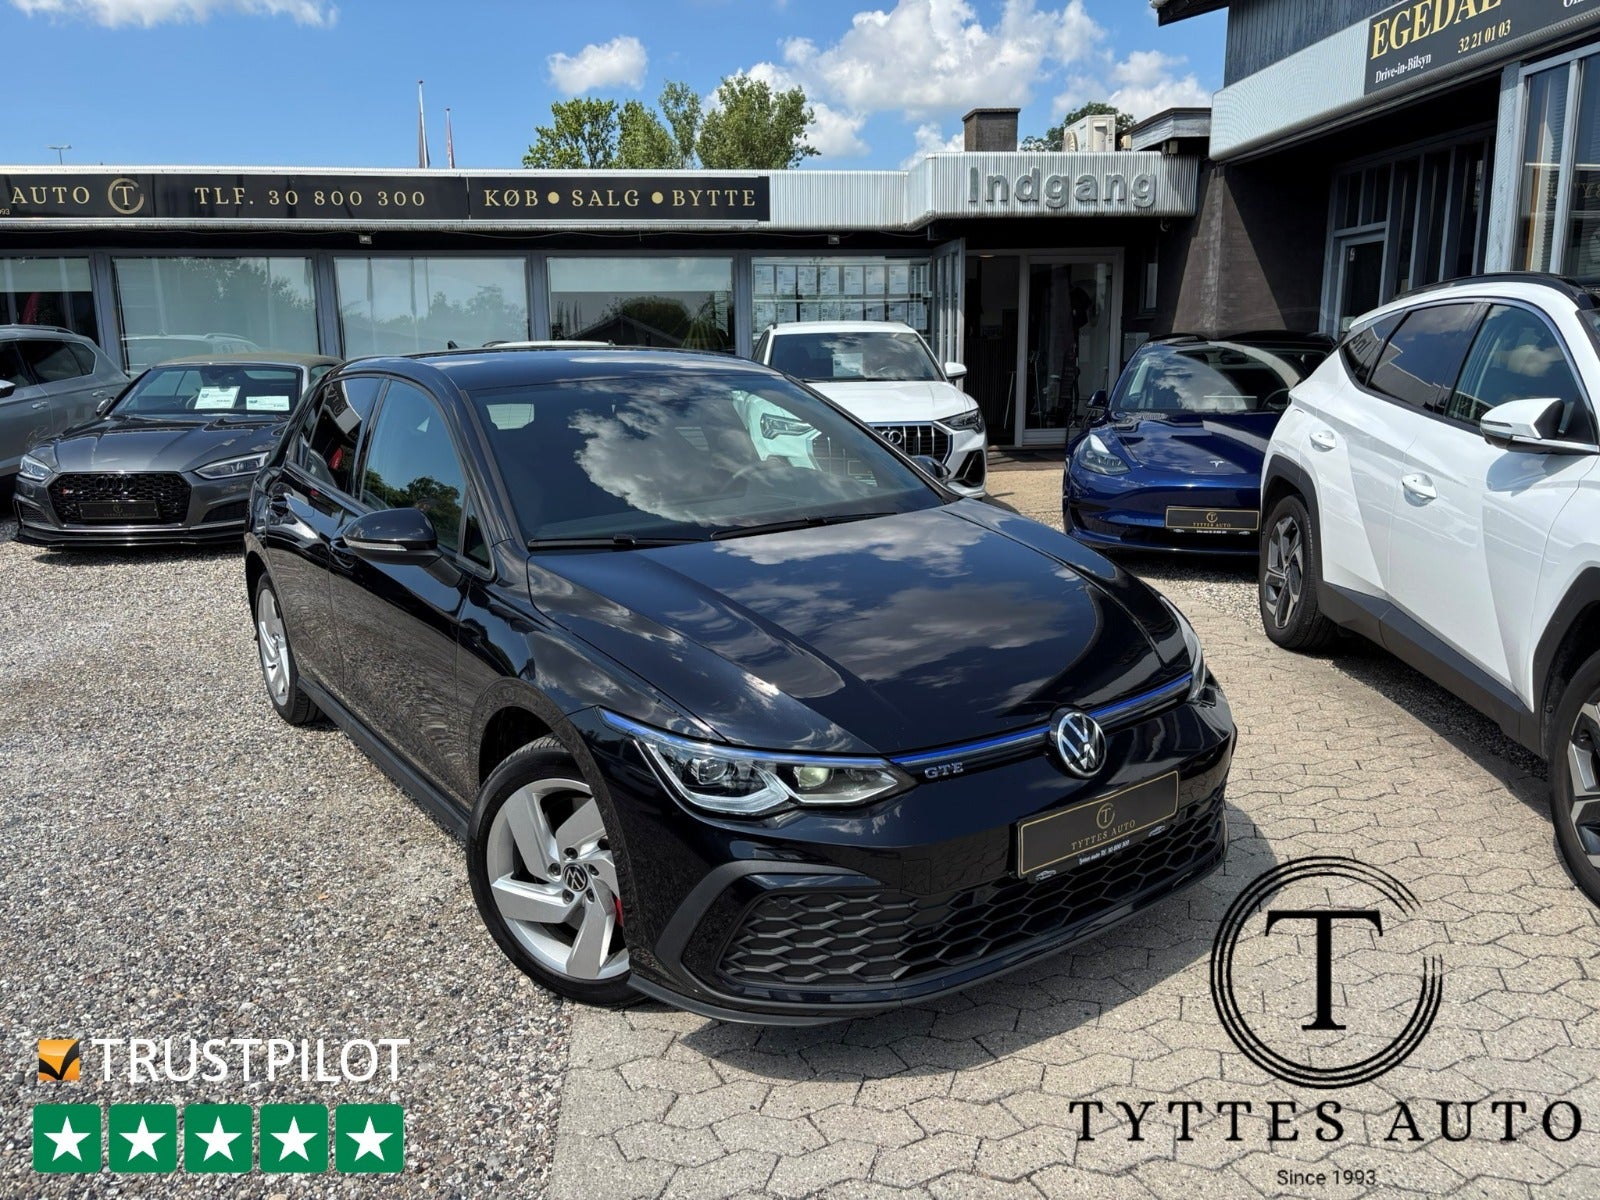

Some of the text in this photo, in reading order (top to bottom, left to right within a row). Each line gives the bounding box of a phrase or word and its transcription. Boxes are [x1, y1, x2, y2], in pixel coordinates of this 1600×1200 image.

[1458, 19, 1511, 54] 32 21 01 03
[1375, 53, 1432, 84] Drive-in-Bilsyn
[11, 186, 90, 204] AUTO
[194, 187, 425, 207] TLF. 30 800 300
[484, 188, 756, 208] KØB SALG BYTTE
[967, 166, 1158, 209] Indgang
[924, 761, 964, 779] GTE
[1071, 819, 1136, 850] TYTTES AUTO
